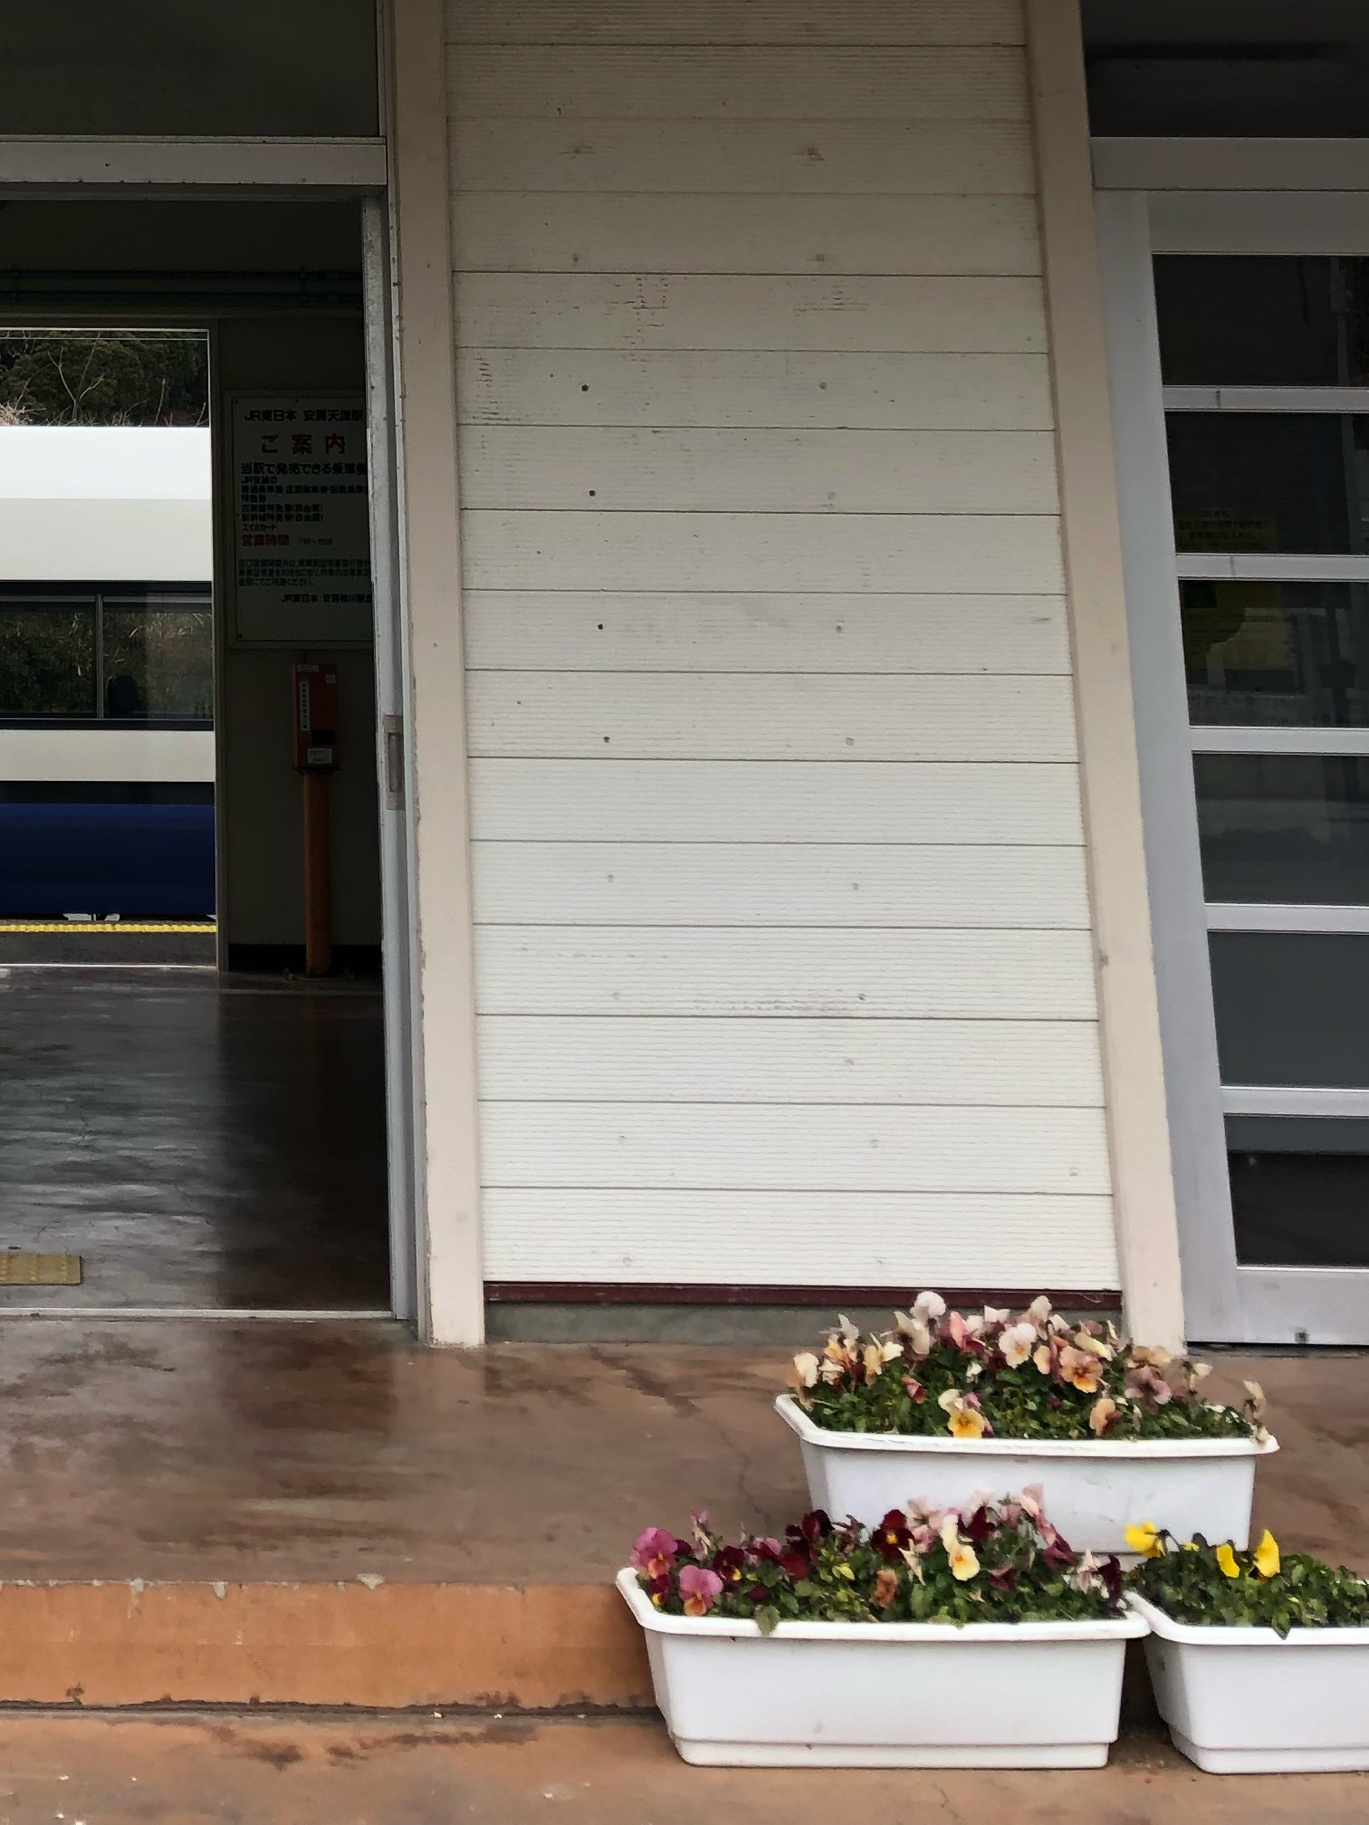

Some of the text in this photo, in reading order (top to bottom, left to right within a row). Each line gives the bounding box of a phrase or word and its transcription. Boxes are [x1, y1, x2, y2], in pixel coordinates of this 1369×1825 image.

[244, 409, 364, 422] JR東日本 安房天津駅
[261, 433, 346, 455] ご案内
[242, 533, 290, 547] 営業時間
